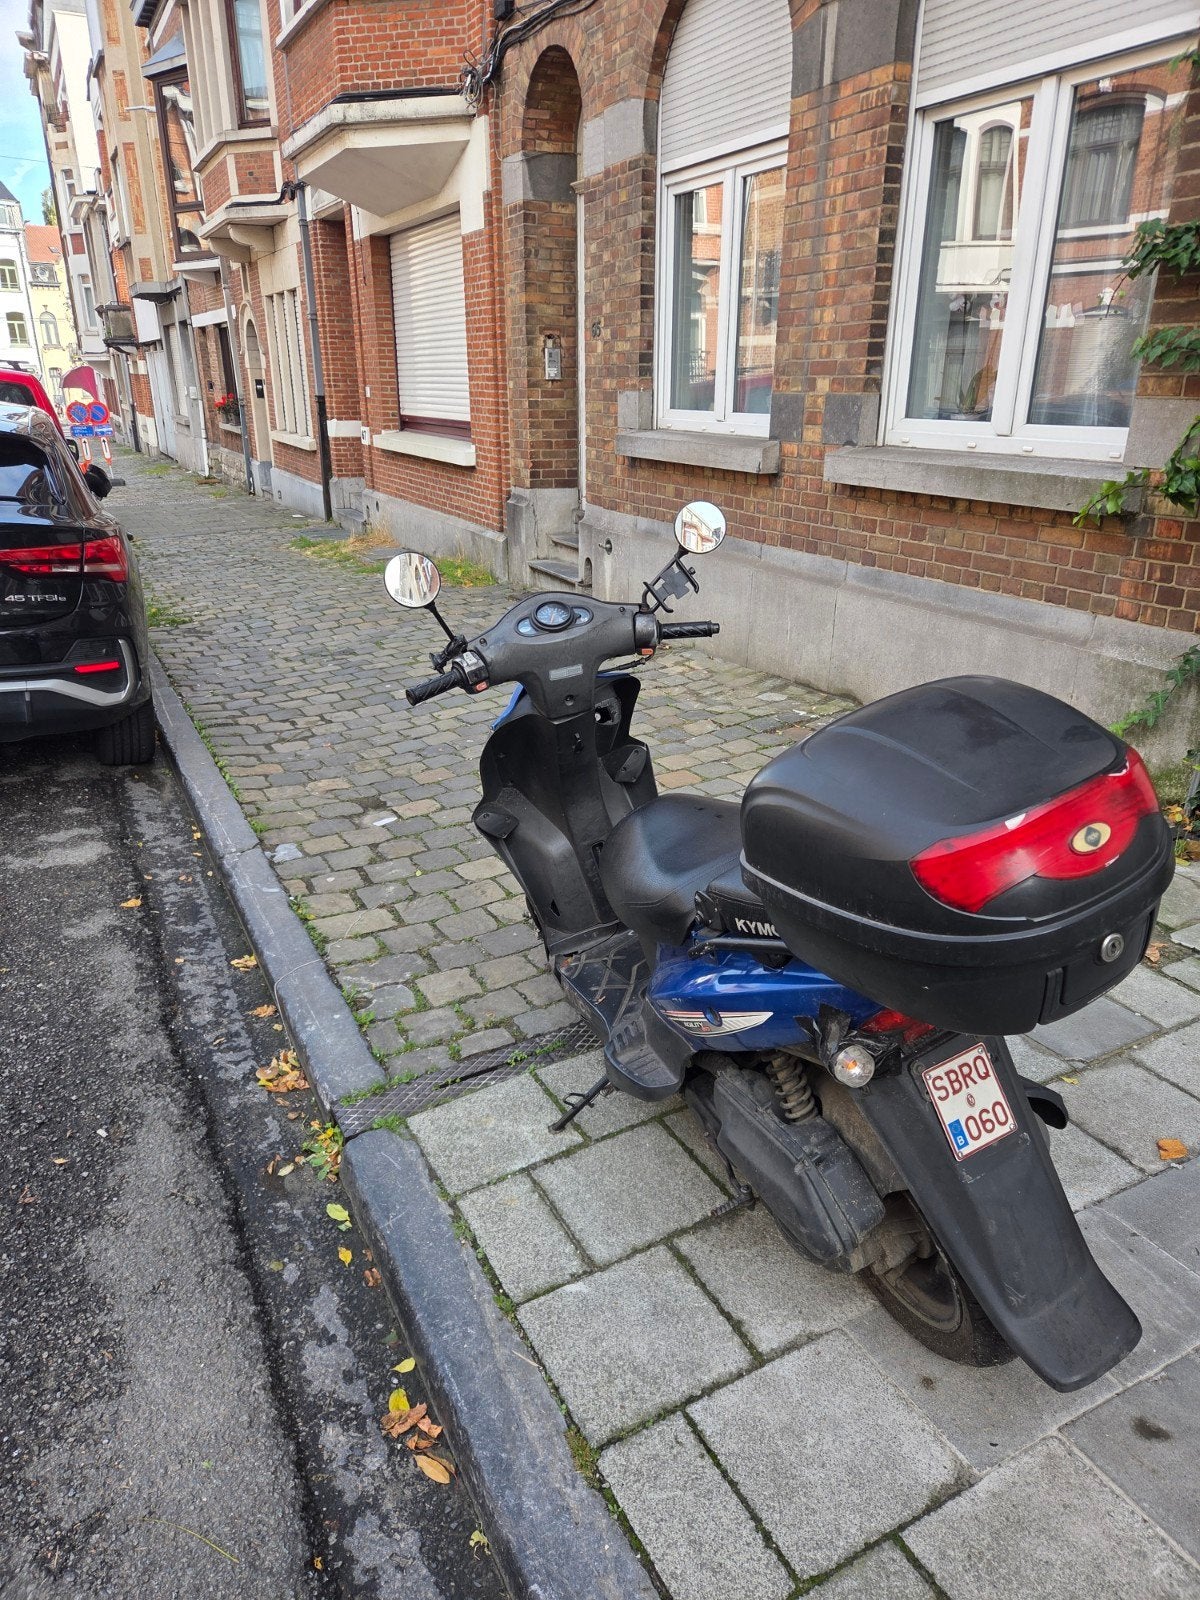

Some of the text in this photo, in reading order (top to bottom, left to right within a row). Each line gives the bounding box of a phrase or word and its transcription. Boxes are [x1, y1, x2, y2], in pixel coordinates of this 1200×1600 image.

[4, 594, 26, 602] 45
[931, 1055, 990, 1102] SBRQ
[964, 1101, 1009, 1141] 060
[957, 1136, 965, 1146] B
